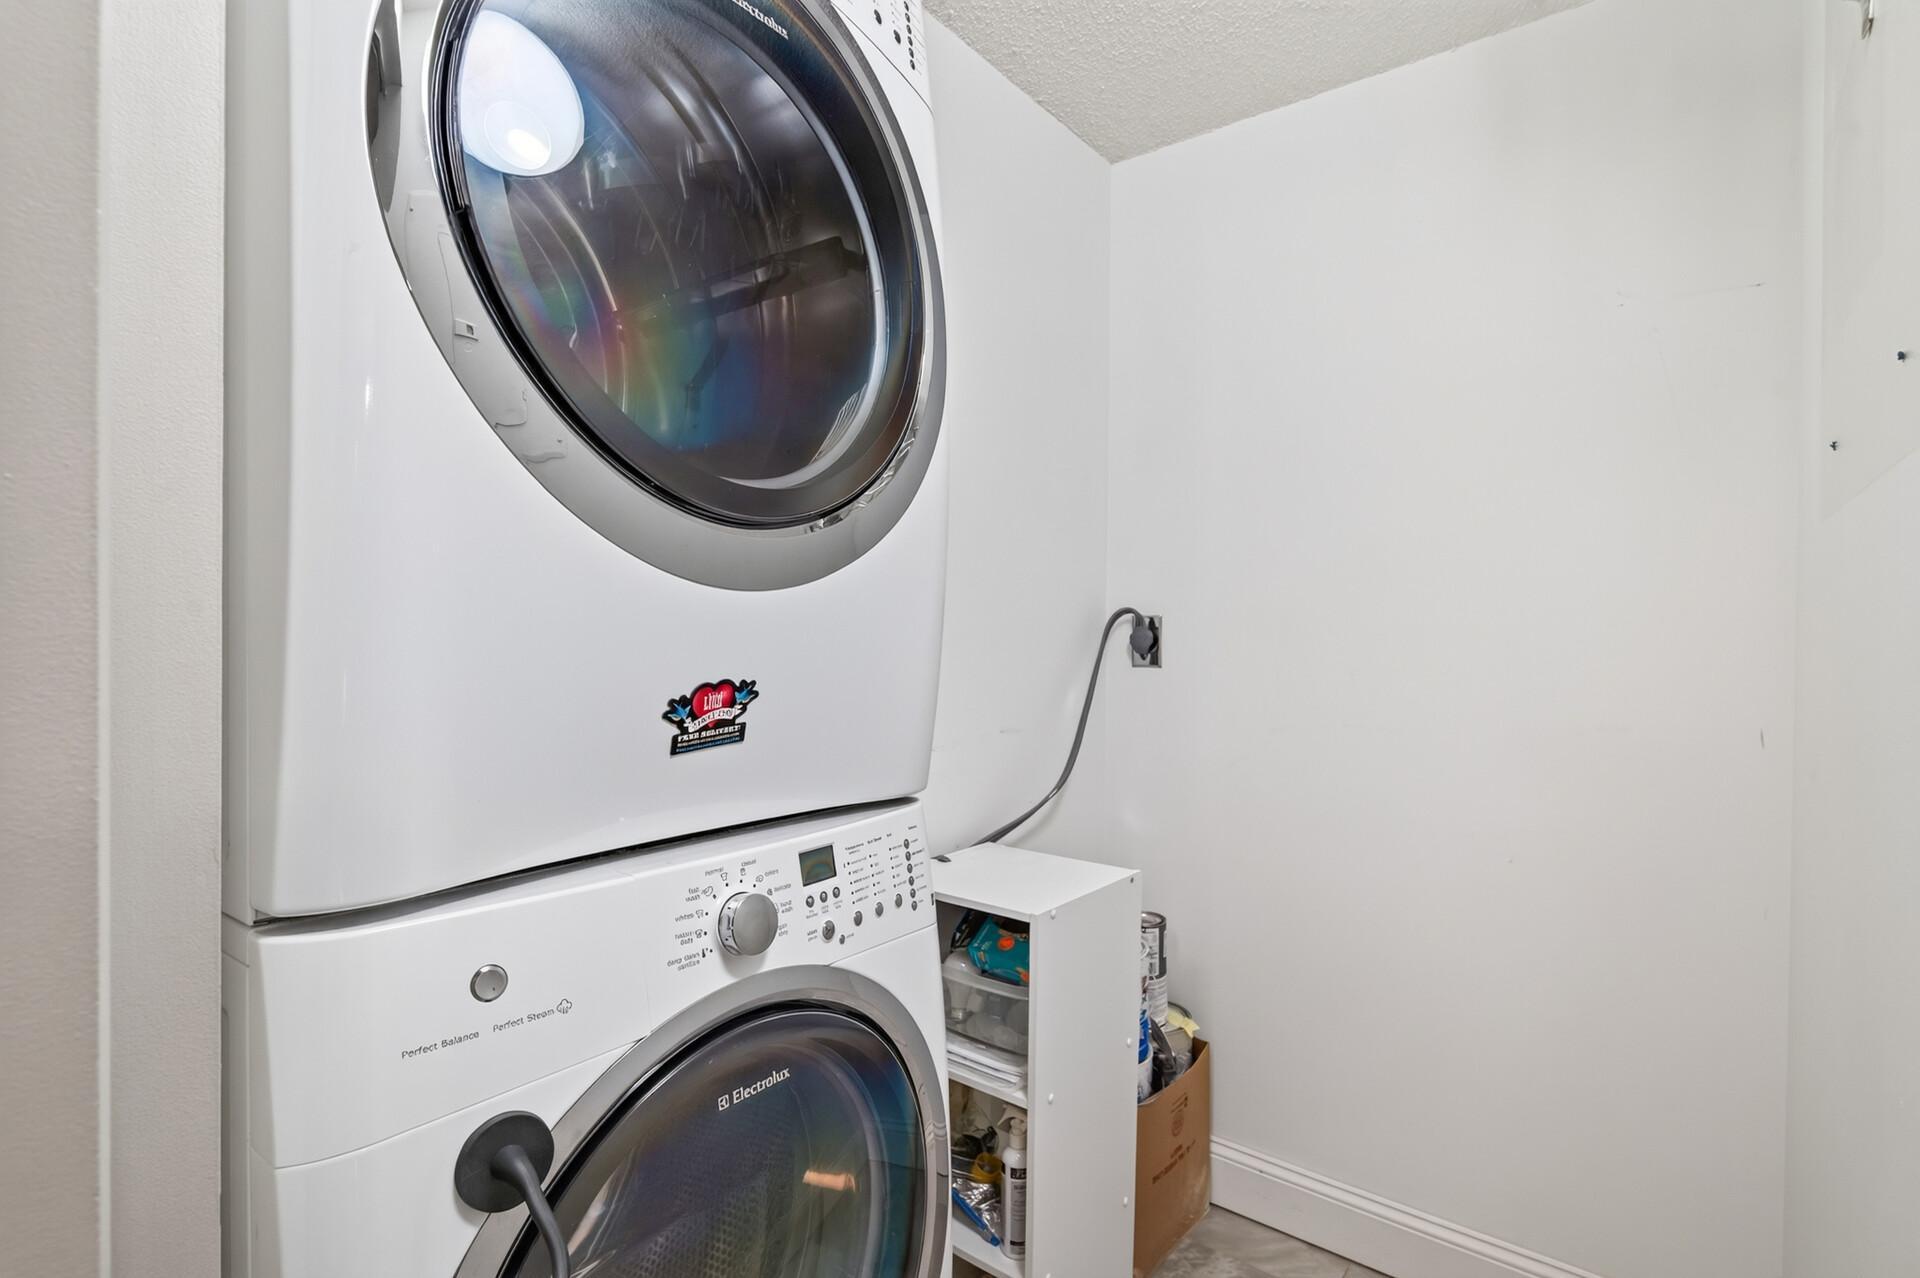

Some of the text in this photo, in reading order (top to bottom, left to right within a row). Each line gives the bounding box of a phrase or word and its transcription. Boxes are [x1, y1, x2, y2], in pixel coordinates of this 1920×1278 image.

[731, 0, 789, 40] lectrolux
[492, 1008, 555, 1033] Perfect Steam
[401, 1031, 480, 1059] Perfect Balance
[732, 1067, 791, 1104] Electrolux
